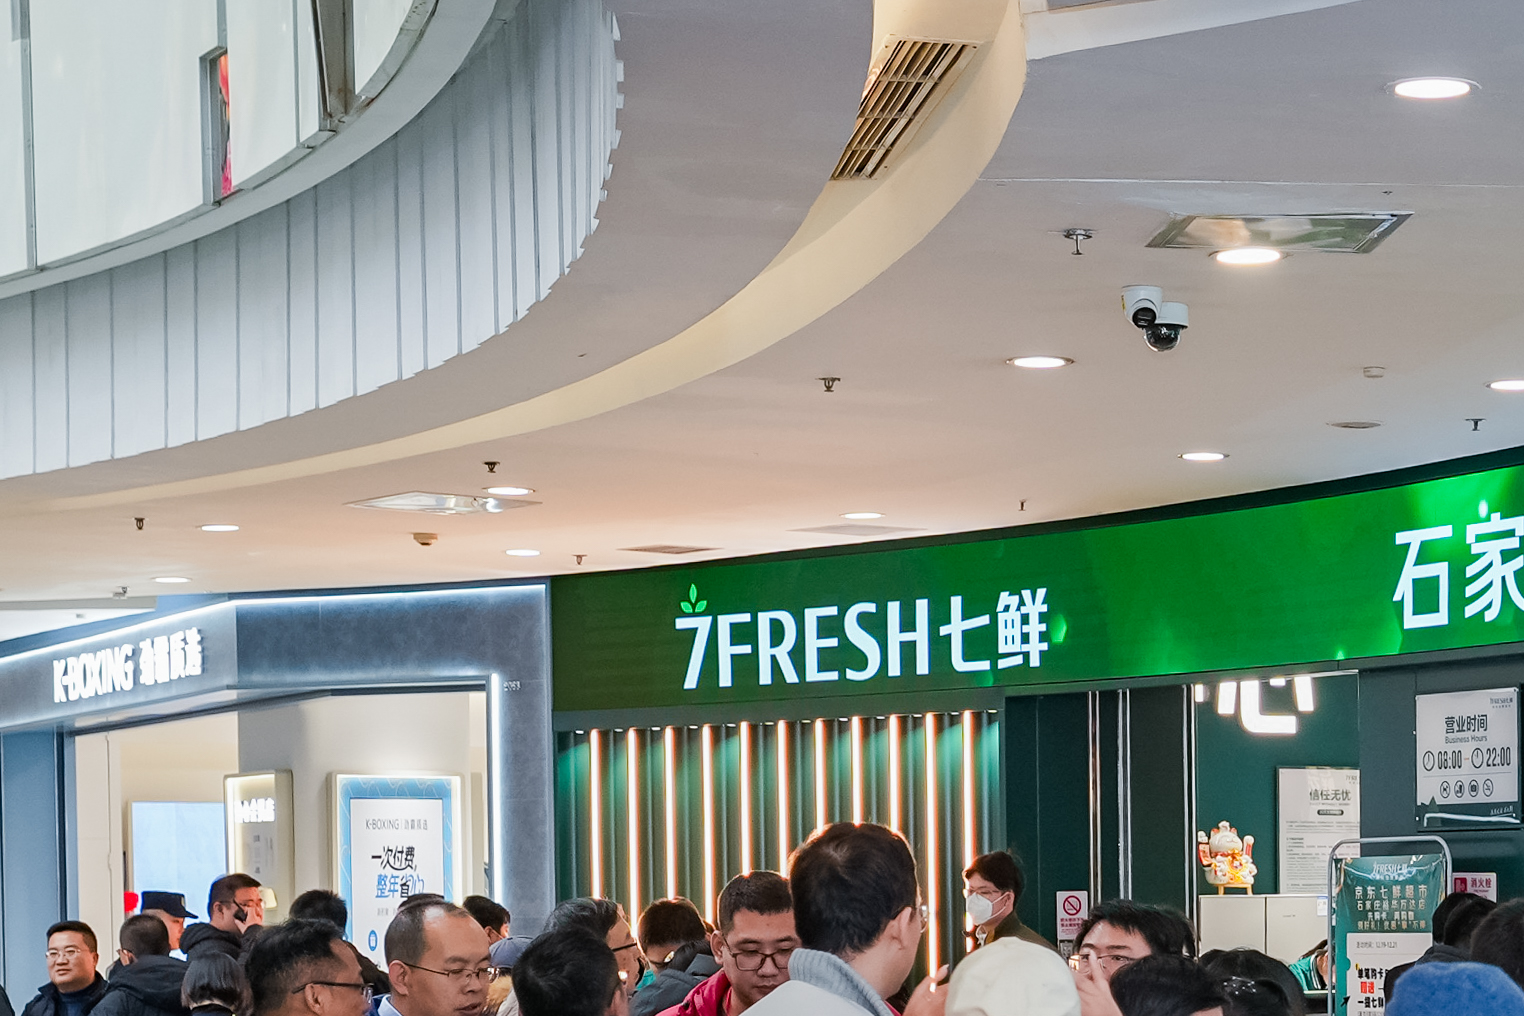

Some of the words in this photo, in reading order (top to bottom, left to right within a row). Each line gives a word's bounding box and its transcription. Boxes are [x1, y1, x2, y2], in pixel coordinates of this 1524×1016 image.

[53, 643, 135, 703] K-BOXING
[1444, 714, 1488, 735] 营业时间
[1444, 735, 1470, 744] Business
[1471, 734, 1488, 743] Hours
[1437, 749, 1463, 770] 08:00
[1486, 746, 1511, 767] 22:00
[1309, 788, 1352, 802] 信任无忧
[365, 818, 400, 830] K-BOXING
[1470, 877, 1492, 889] 消火栓
[1354, 884, 1428, 900] 京东七鲜超市
